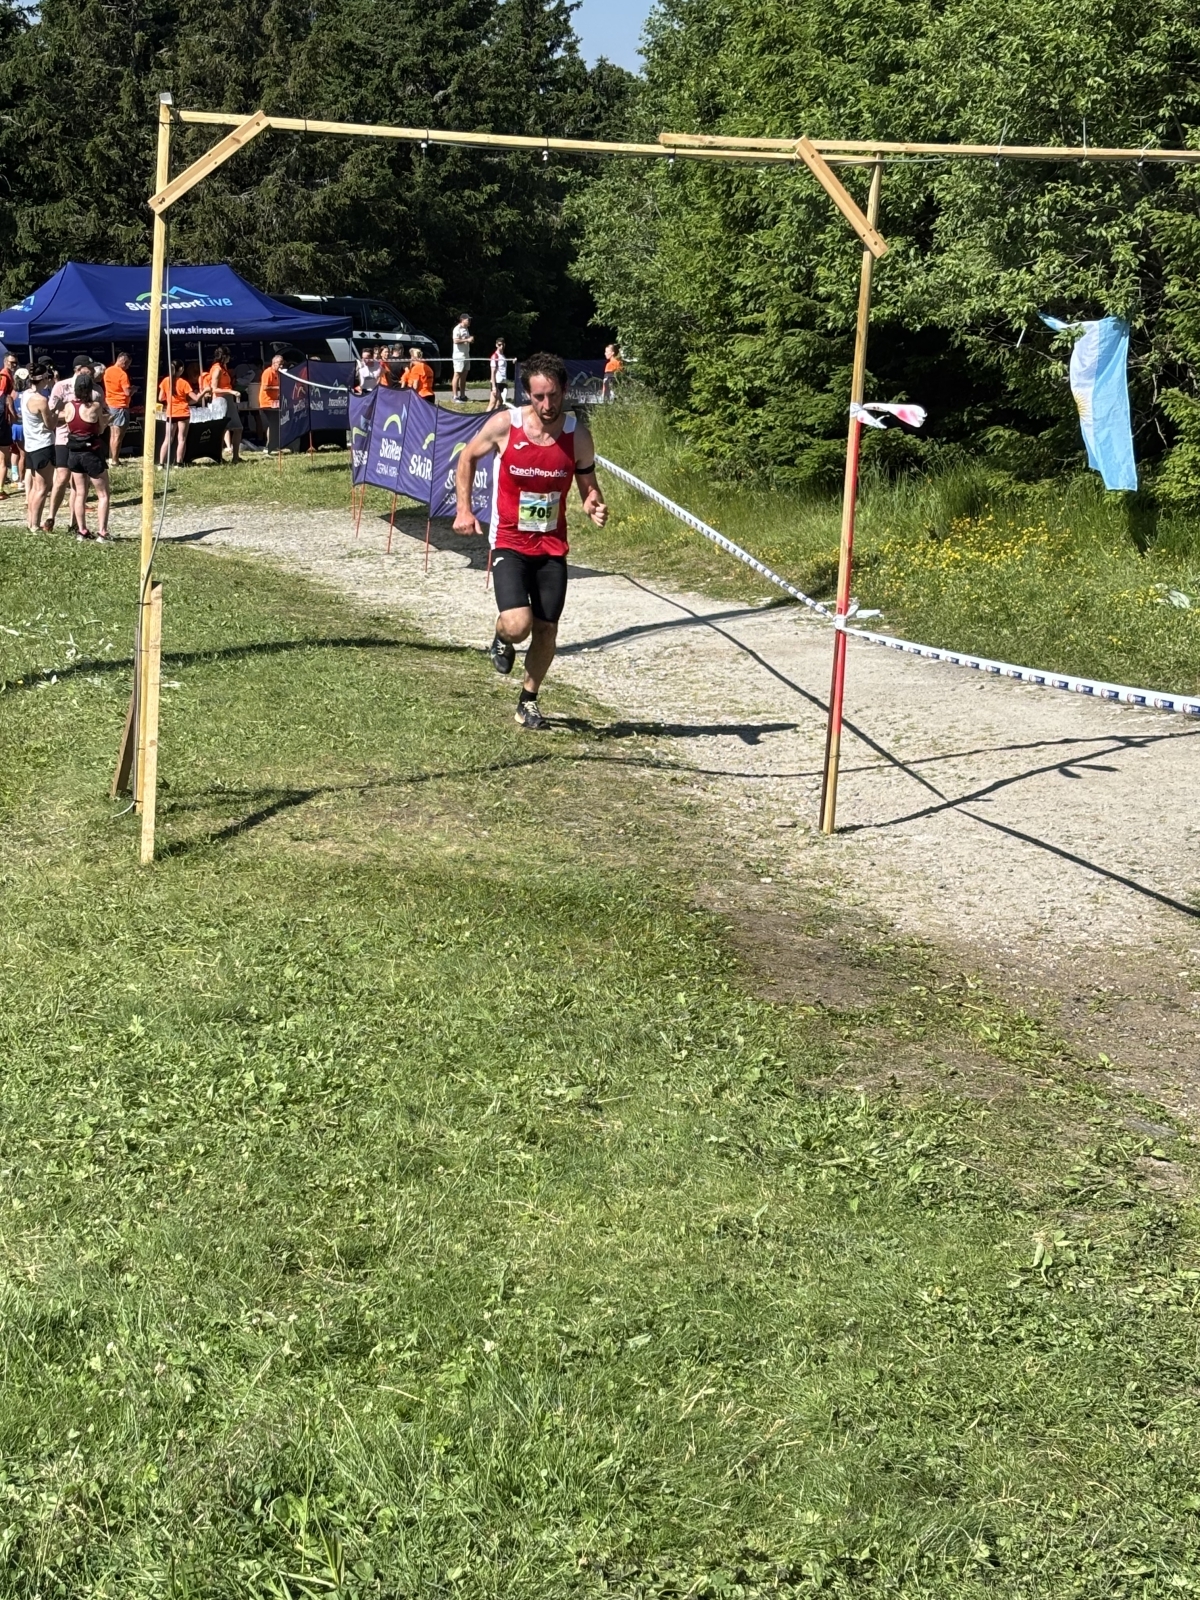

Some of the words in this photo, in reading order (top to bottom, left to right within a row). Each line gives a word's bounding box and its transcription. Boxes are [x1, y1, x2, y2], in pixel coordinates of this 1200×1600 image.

[125, 297, 234, 311] SkiesortLive
[164, 325, 235, 336] www.skiresort.cz
[509, 465, 568, 478] CzechRepublic
[529, 506, 552, 519] 705
